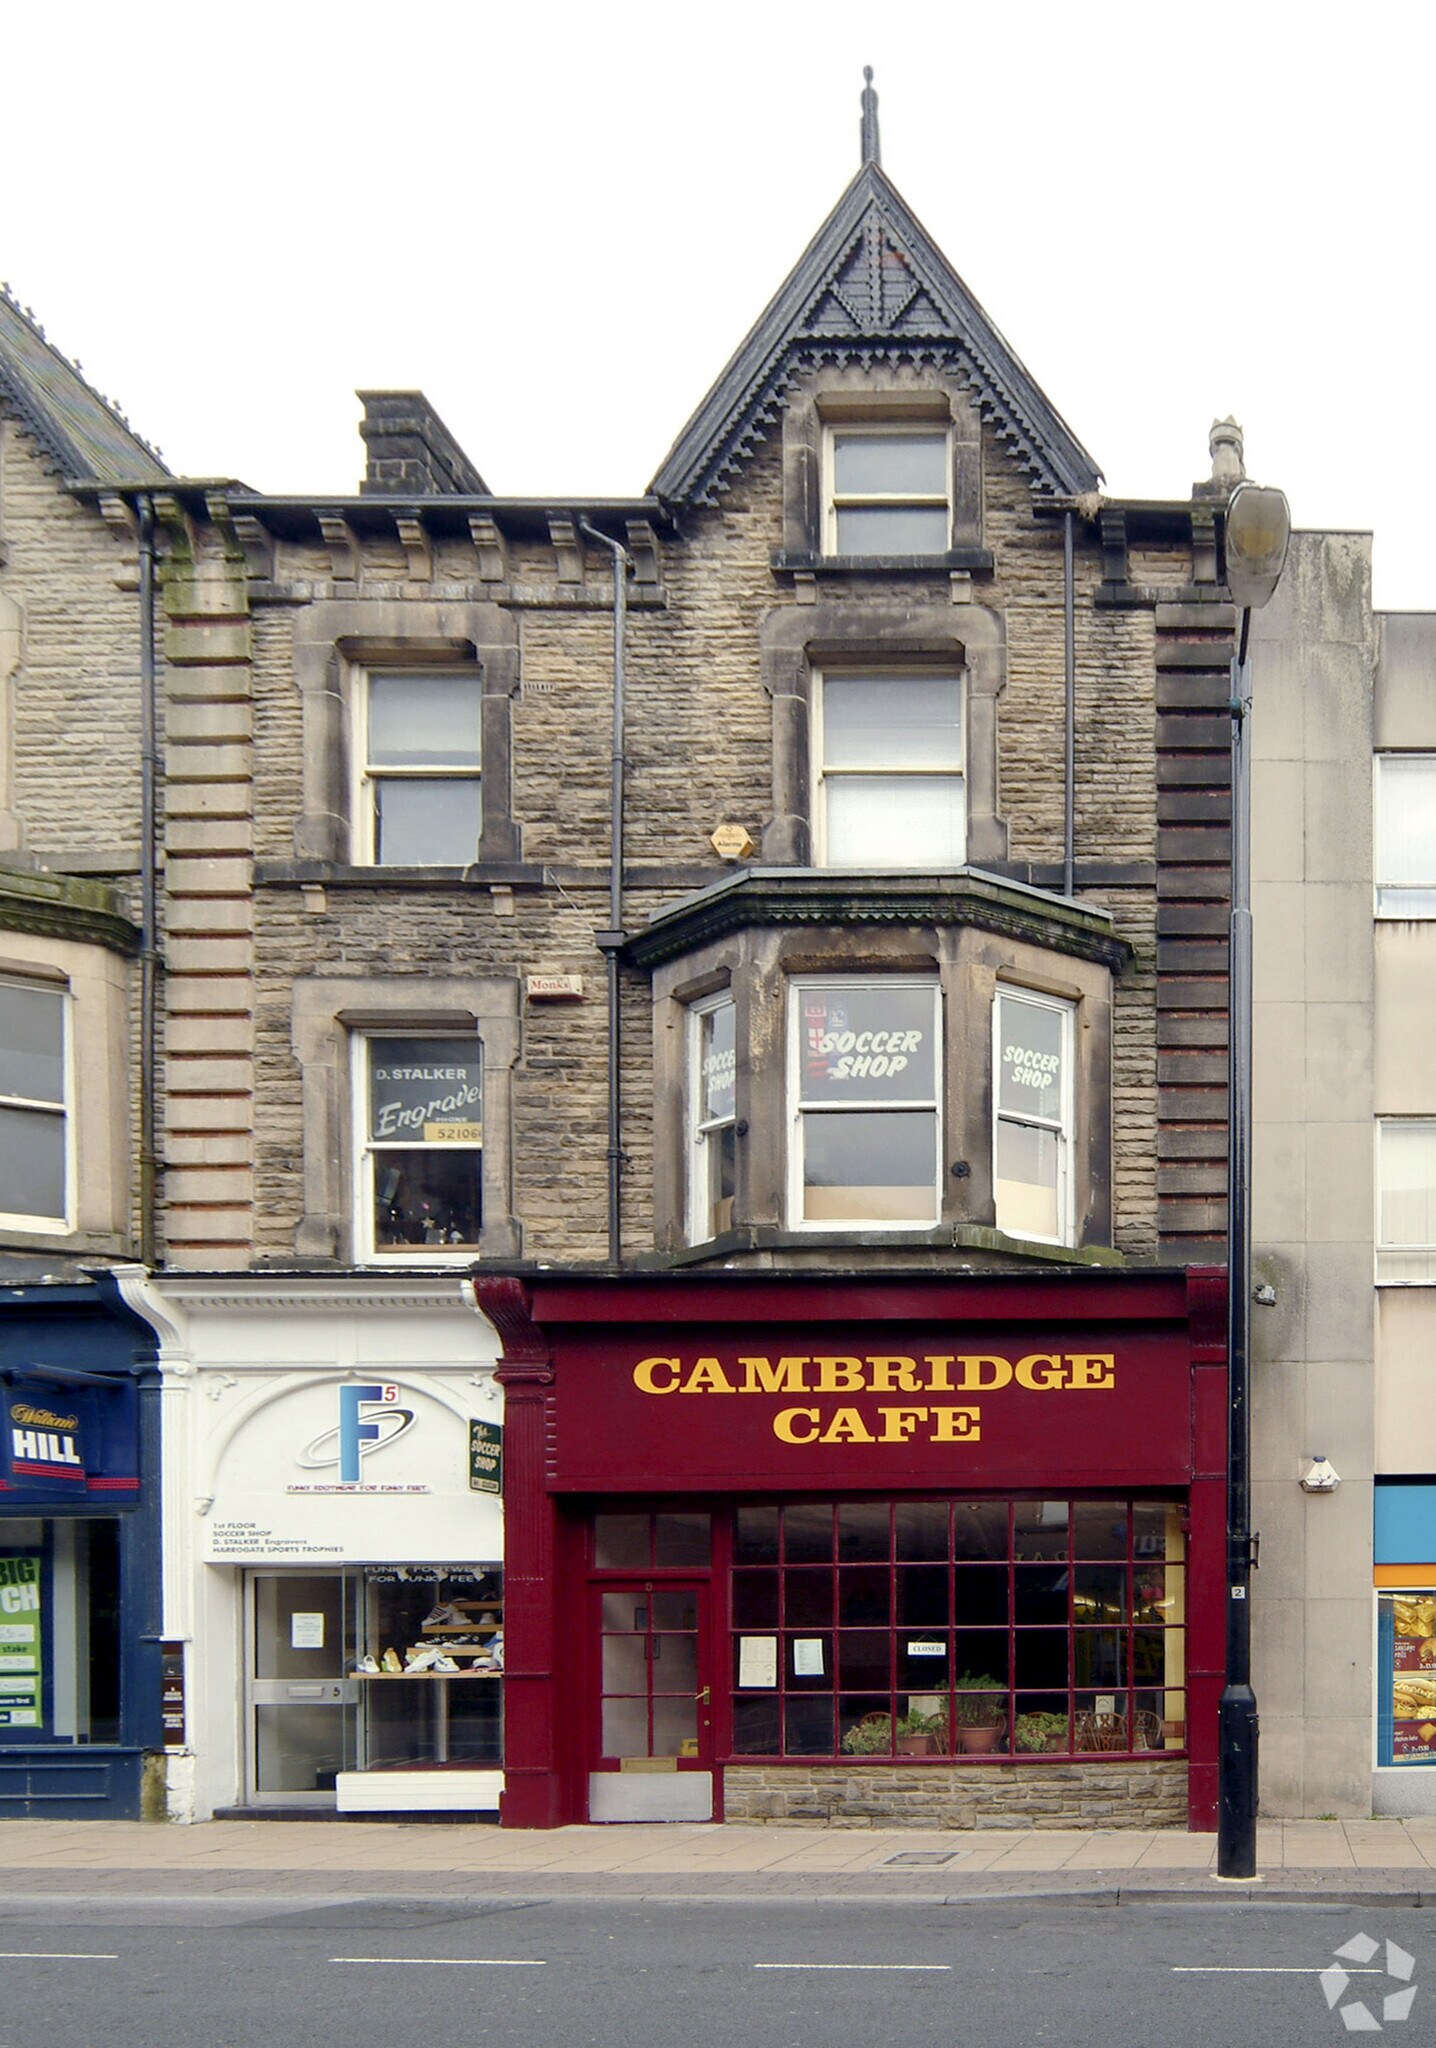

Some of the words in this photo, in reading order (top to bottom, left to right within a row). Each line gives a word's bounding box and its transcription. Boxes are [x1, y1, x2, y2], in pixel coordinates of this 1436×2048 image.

[820, 1030, 923, 1054] SOCCER
[702, 1048, 736, 1076] SOCCE
[837, 1054, 909, 1078] SHOP
[1002, 1045, 1060, 1074] SOCCER
[1011, 1066, 1053, 1090] SHOP
[373, 1084, 482, 1138] Engrave
[633, 1353, 1116, 1394] CAMBRIDGE
[772, 1406, 981, 1444] CAFE
[12, 1428, 81, 1464] HILL
[471, 1439, 501, 1457] SOCCER
[474, 1455, 497, 1472] SHOP
[360, 1484, 378, 1492] FOR
[369, 1575, 396, 1583] FOR
[450, 1575, 484, 1583] FEE
[0, 1584, 40, 1614] CH
[1234, 1588, 1242, 1597] 2
